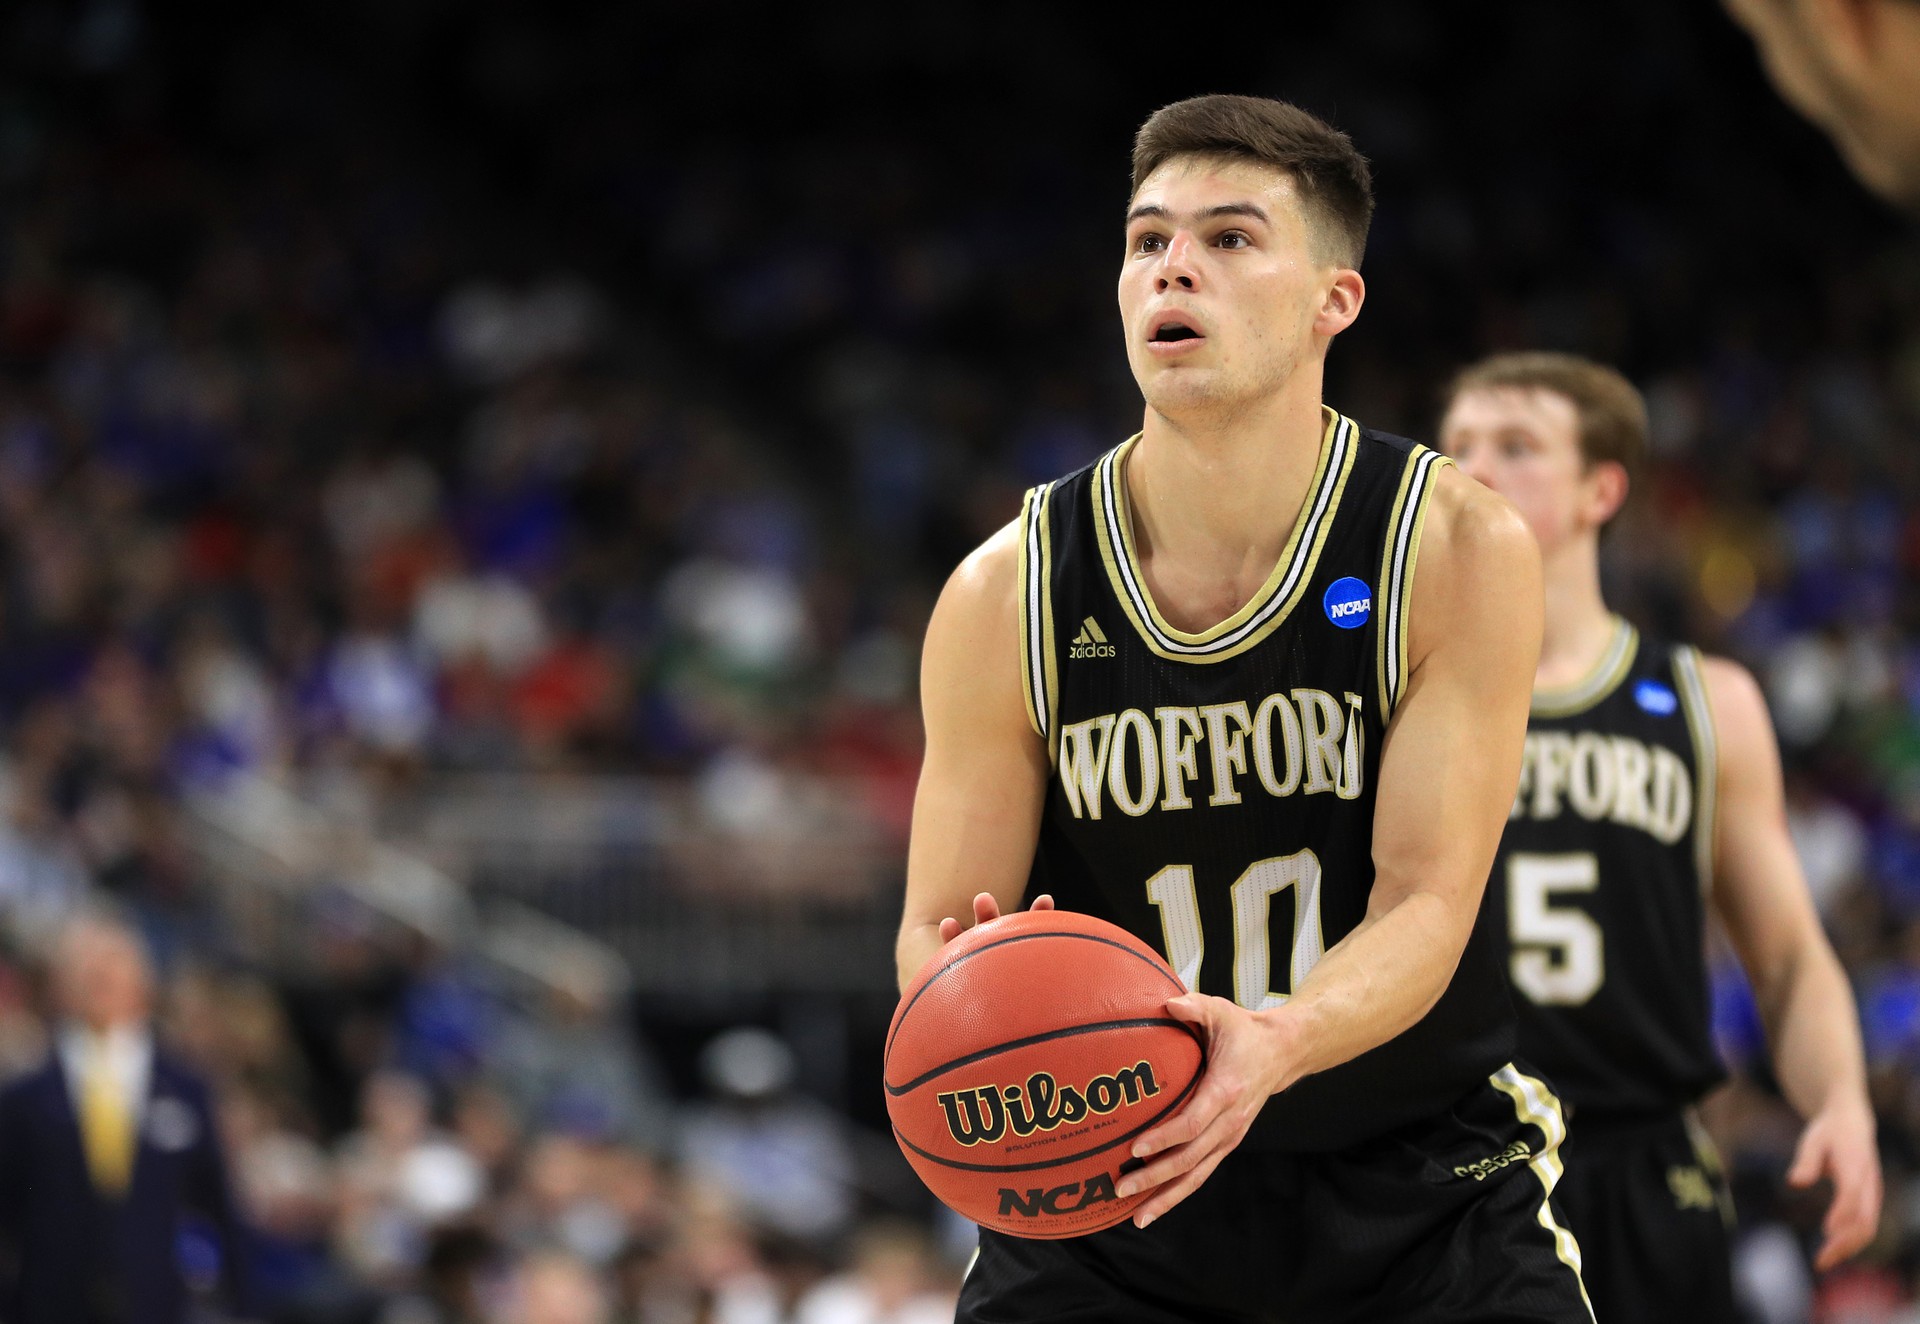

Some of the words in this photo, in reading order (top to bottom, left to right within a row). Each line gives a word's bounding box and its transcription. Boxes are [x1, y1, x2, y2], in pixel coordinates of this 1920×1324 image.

[1331, 598, 1371, 618] NCAA
[1070, 642, 1116, 659] adidas
[1145, 847, 1326, 1012] 10
[1505, 852, 1605, 1007] 5
[937, 1060, 1160, 1147] Wilson
[1005, 1136, 1057, 1153] SOLUTION
[1059, 1126, 1091, 1140] GAME
